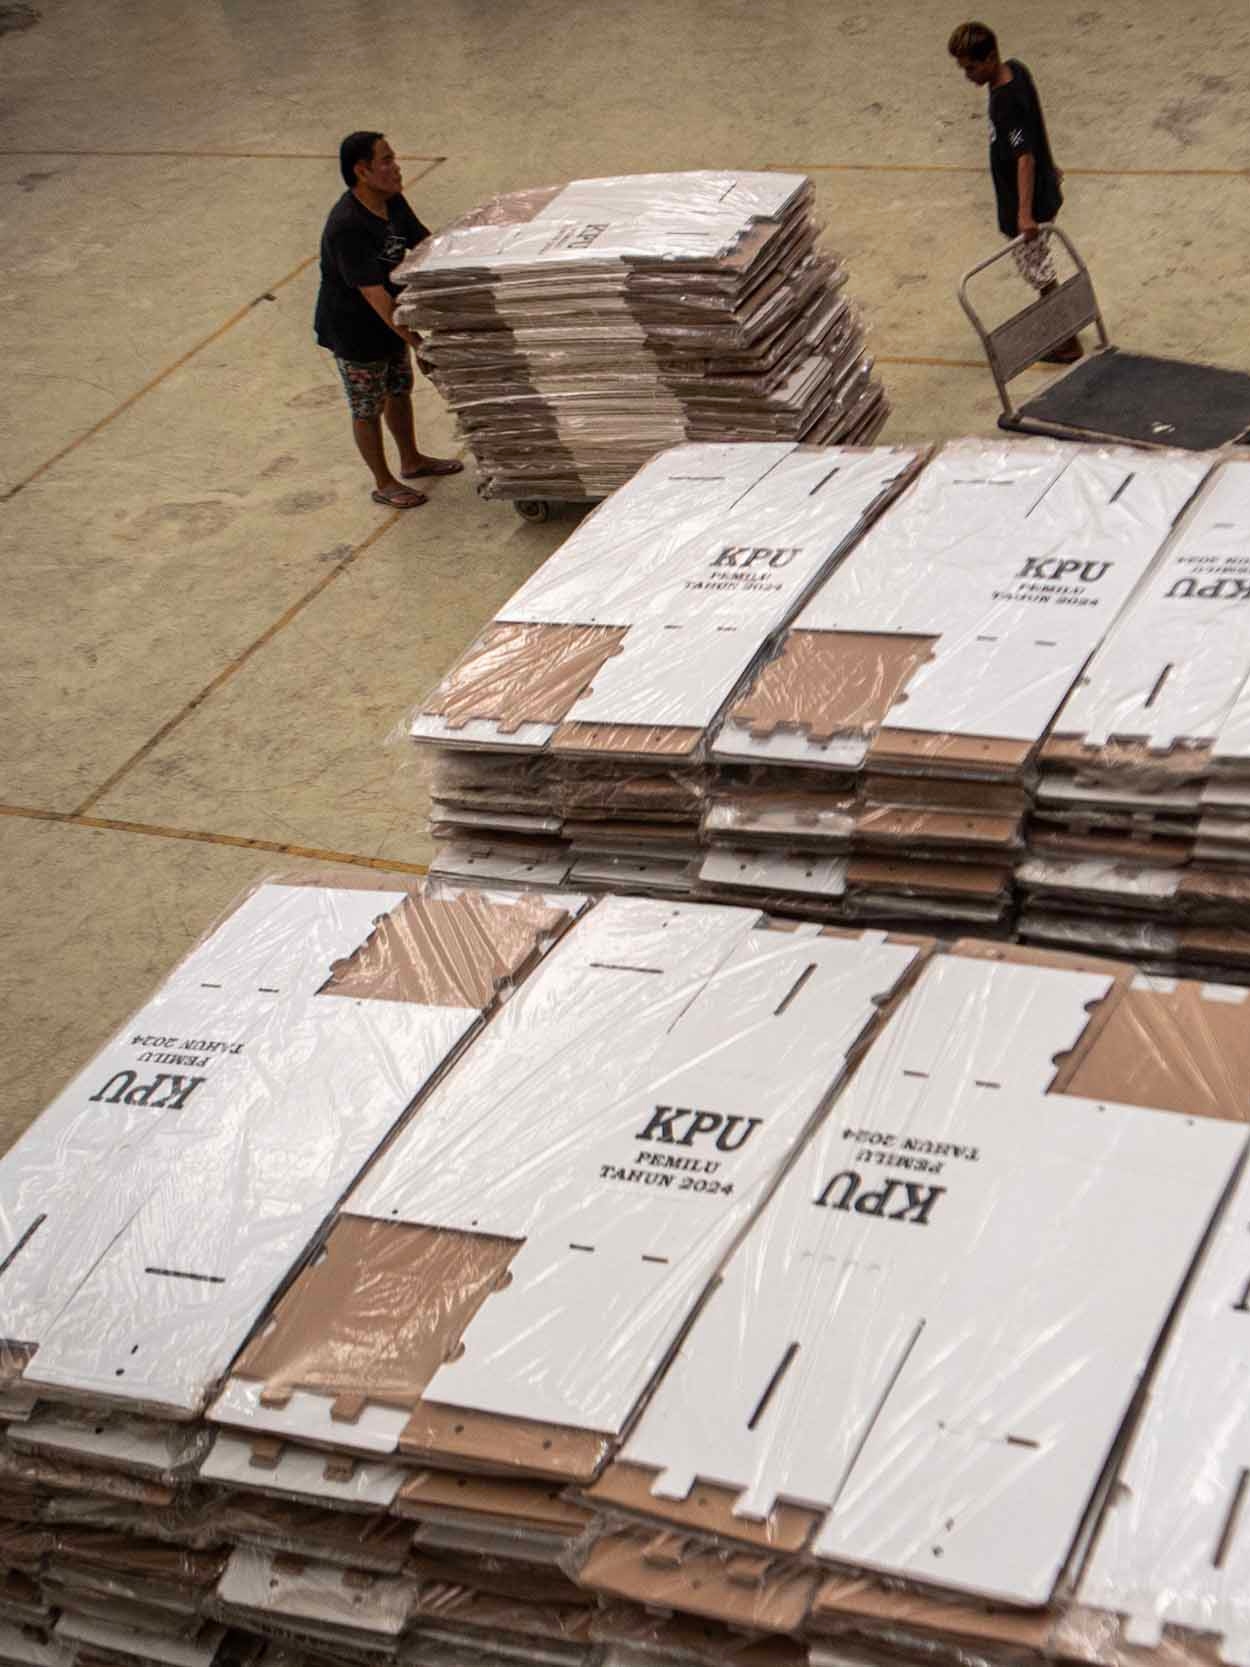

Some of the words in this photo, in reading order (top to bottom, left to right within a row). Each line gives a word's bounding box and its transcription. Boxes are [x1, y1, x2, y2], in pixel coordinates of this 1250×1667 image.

[709, 546, 803, 568] KPU
[1016, 556, 1114, 582] KPU
[131, 1034, 179, 1046] 2024
[179, 1039, 244, 1055] TAHUN
[137, 1051, 211, 1067] PEMILU
[88, 1070, 206, 1110] KPU
[635, 1105, 762, 1153] KPU
[842, 1128, 896, 1145] 2024
[635, 1150, 721, 1174] PEMILU
[902, 1138, 981, 1162] TAHUN
[856, 1151, 944, 1175] PEMILU
[600, 1164, 674, 1188] TAHUN
[678, 1174, 734, 1196] 2024
[813, 1170, 947, 1225] KPU
